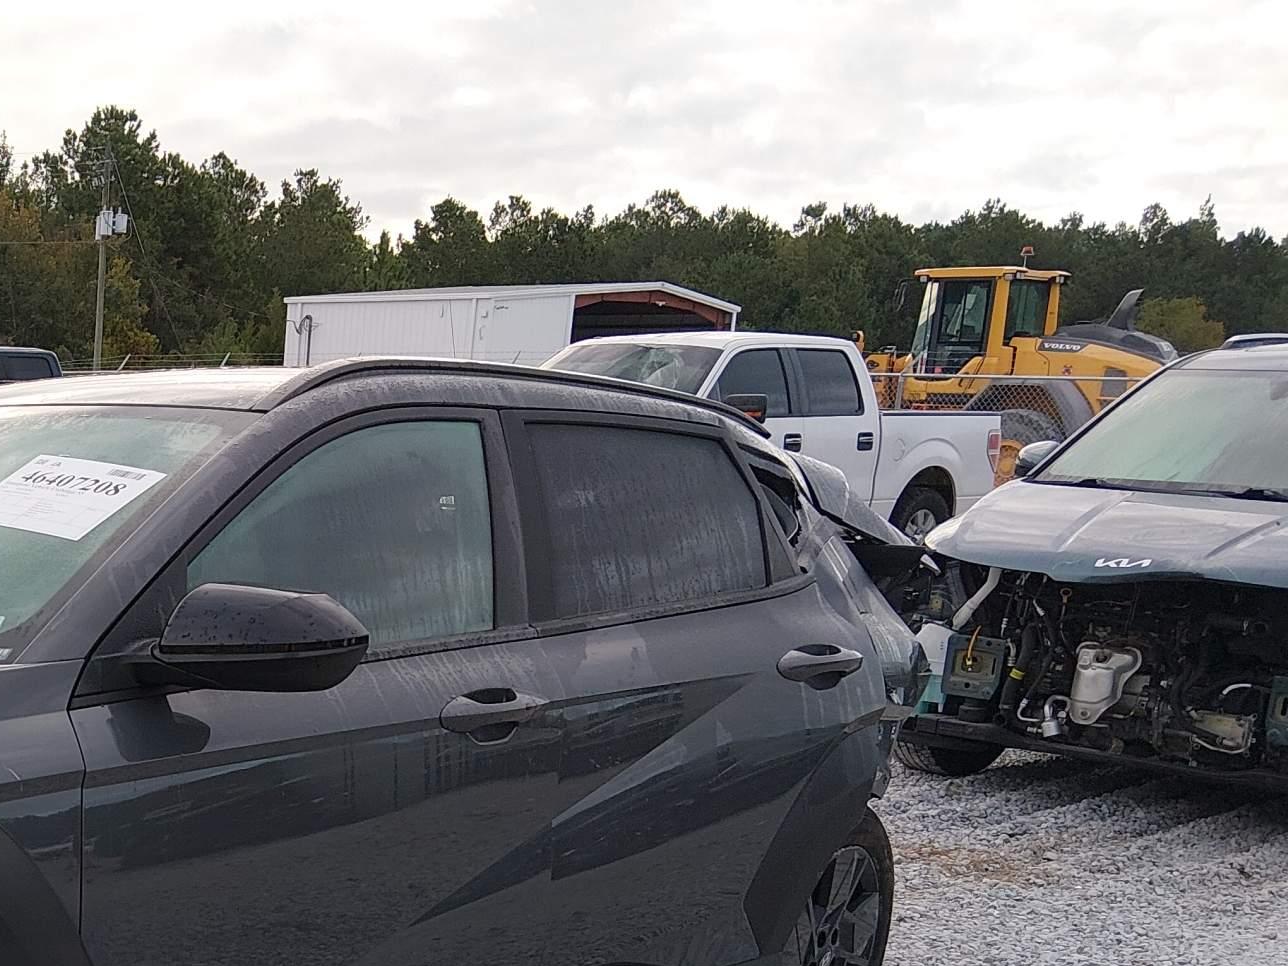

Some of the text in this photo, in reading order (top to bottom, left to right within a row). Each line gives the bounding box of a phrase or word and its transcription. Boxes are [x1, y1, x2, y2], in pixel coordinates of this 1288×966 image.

[1043, 342, 1082, 351] VOLVO
[21, 470, 127, 496] 46407208
[1094, 558, 1153, 568] KIA
